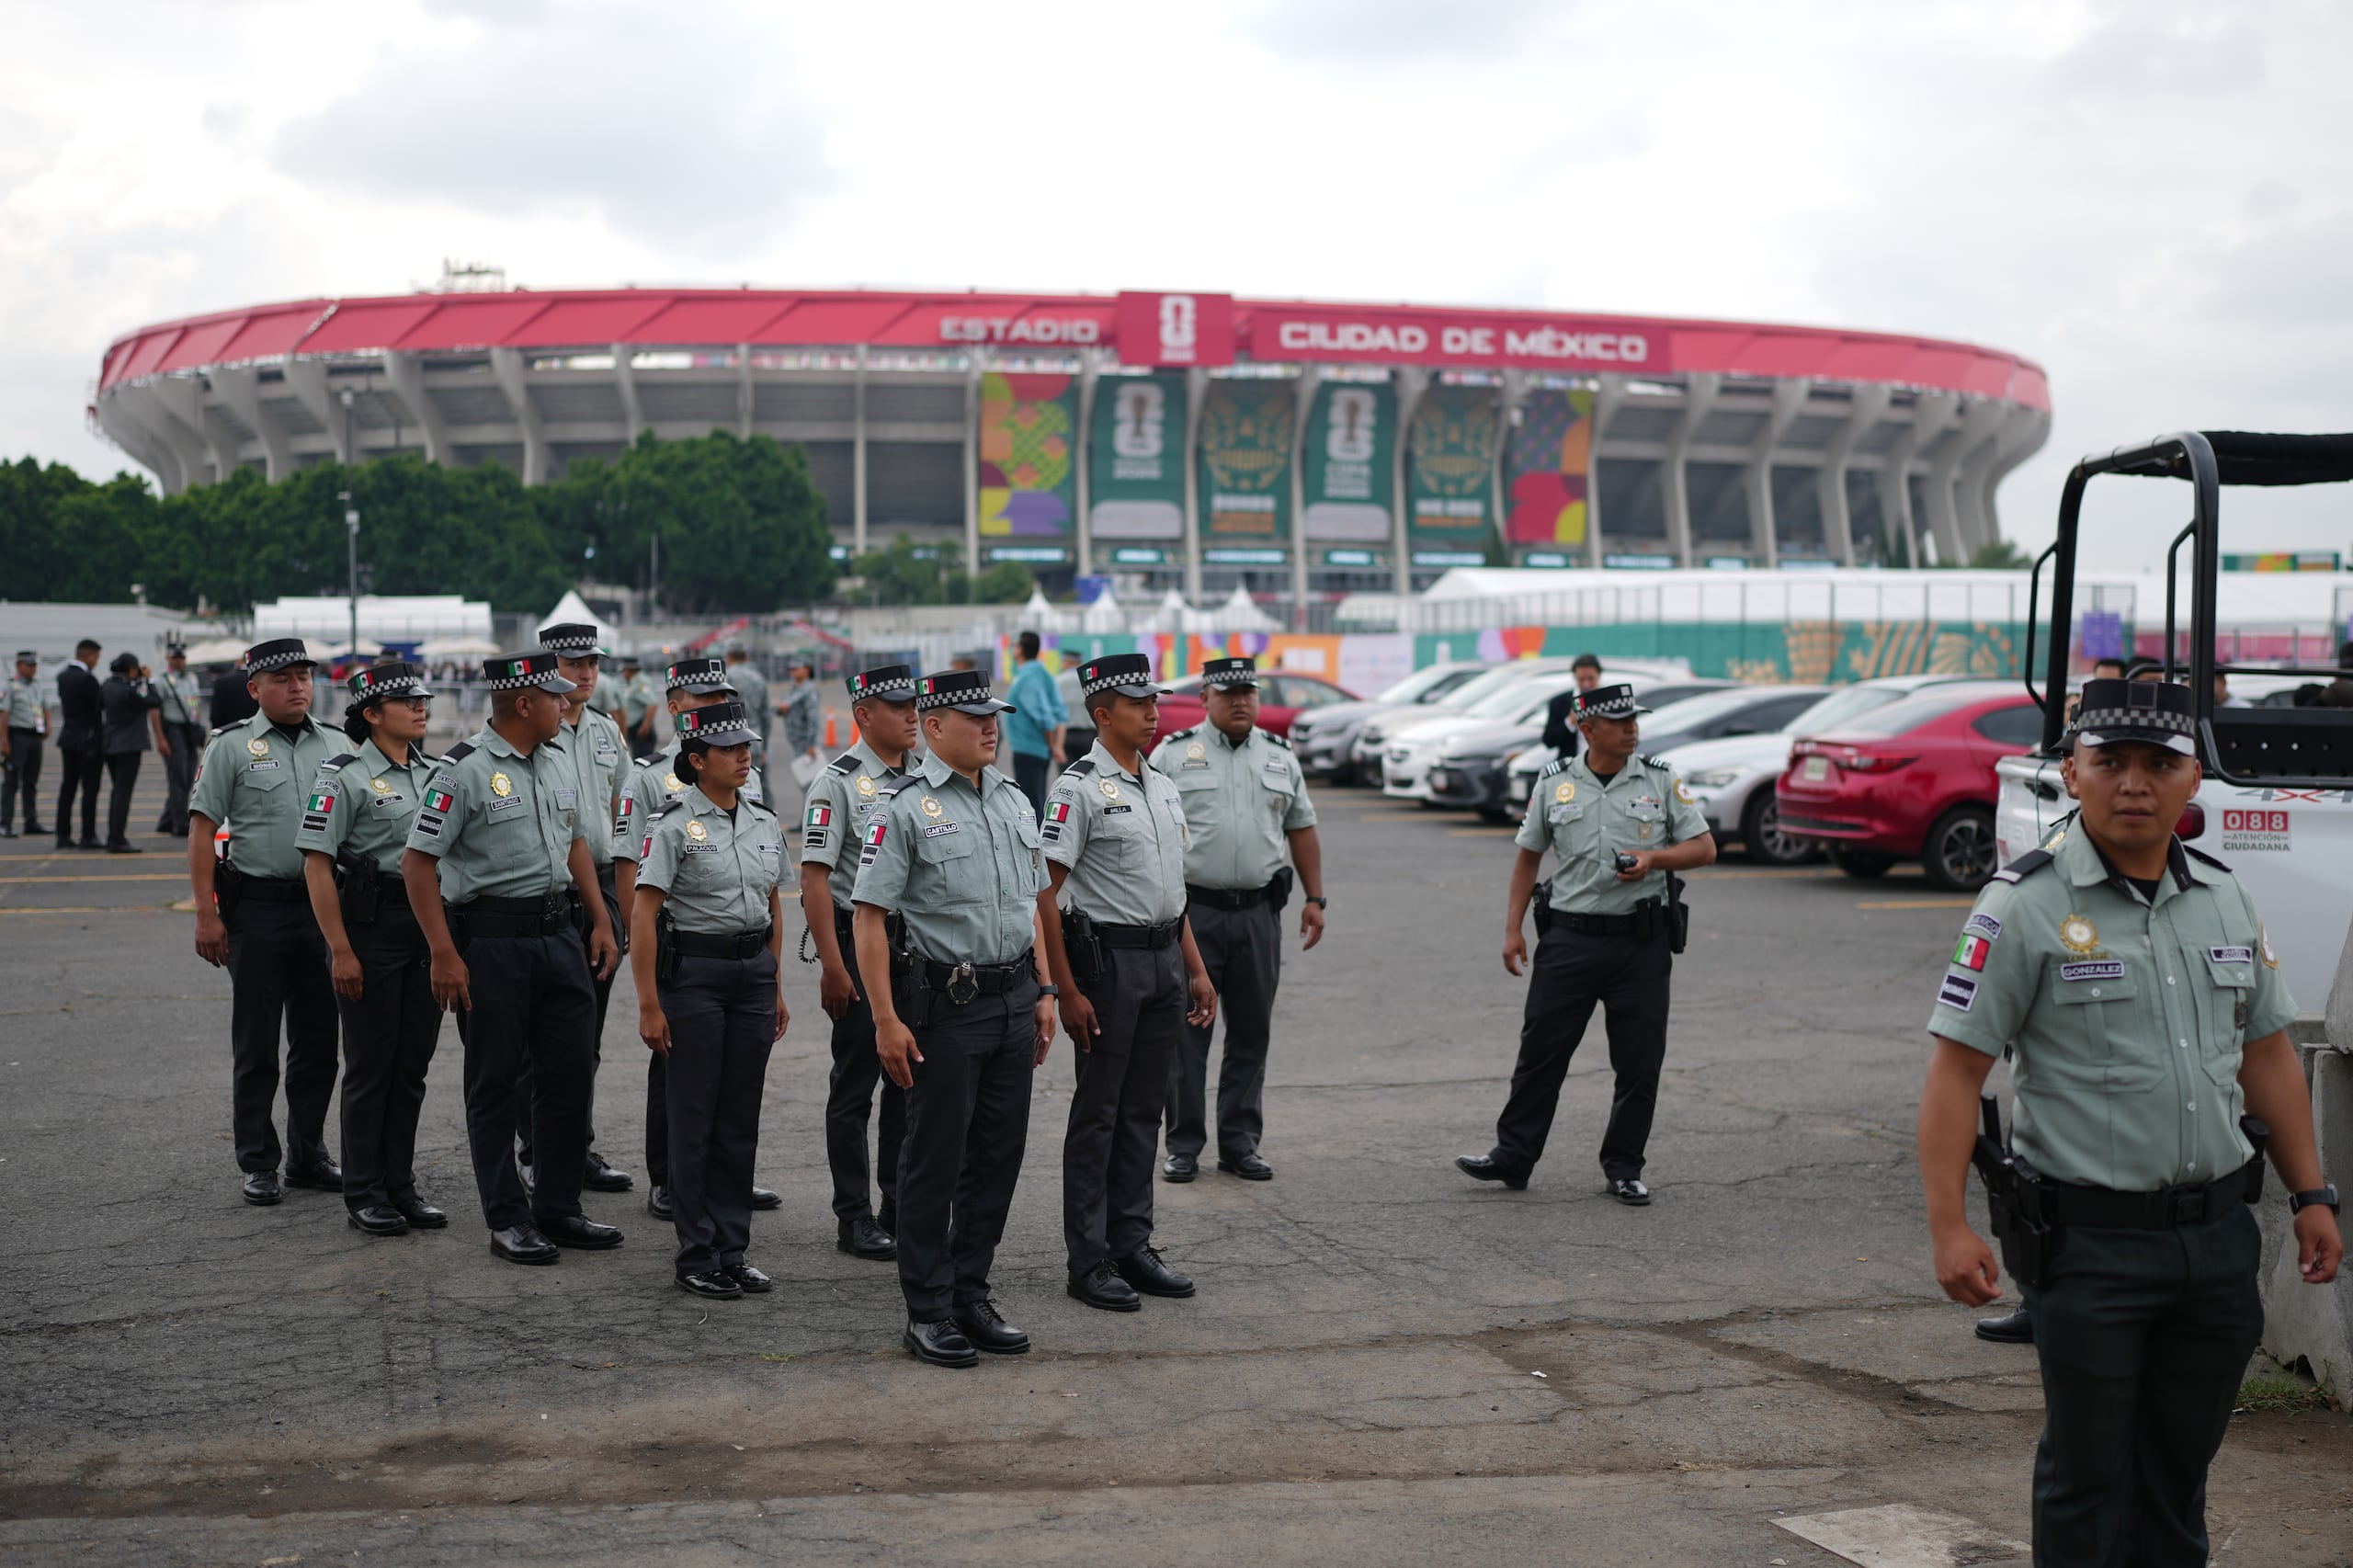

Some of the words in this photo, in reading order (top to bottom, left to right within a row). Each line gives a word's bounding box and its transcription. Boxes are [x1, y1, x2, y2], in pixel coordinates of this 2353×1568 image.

[940, 317, 1099, 342] ESTADIO
[1279, 322, 1428, 352] CIUDAD
[1441, 328, 1495, 355] DE
[1506, 325, 1648, 361] MÉXICO
[317, 781, 340, 792] MEXICO
[434, 775, 457, 788] MEXICO
[494, 796, 518, 808] SANTIAGO
[2225, 812, 2286, 831] 088
[927, 824, 957, 835] CASTILLO
[2232, 833, 2280, 842] ATENCIÓN
[2223, 842, 2290, 852] CIUDADANA
[2064, 964, 2122, 976] GONZALEZ
